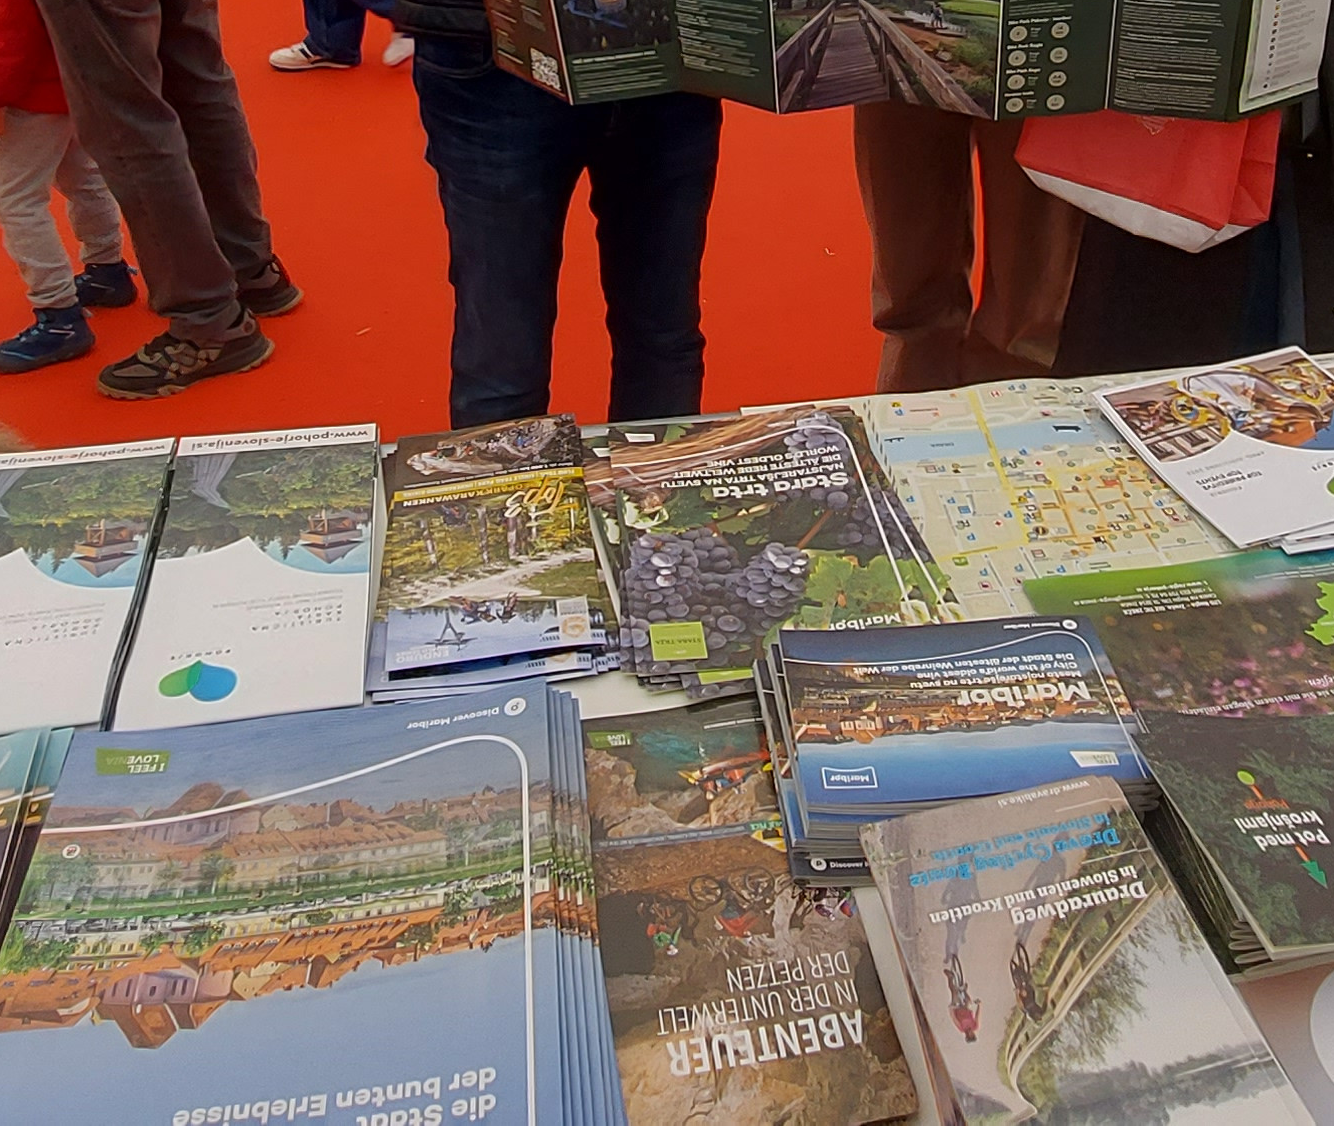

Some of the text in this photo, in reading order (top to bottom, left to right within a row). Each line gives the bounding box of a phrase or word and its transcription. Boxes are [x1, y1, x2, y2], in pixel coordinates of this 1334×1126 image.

[191, 430, 369, 451] www.pohorje-slovenija.si
[673, 453, 841, 479] DIE ÄLTESTE REBE WELTWEIT
[737, 453, 783, 466] OLDEST
[661, 462, 845, 489] NAJSTAREJŠA TRTA NA SVETU
[713, 472, 849, 499] Stara trta
[853, 653, 1075, 675] Die Stadt der ältesten Weinrebe der Welt
[916, 661, 1078, 679] City of the world's oldest vine
[1055, 670, 1082, 679] Mesto
[909, 680, 942, 689] svetu
[944, 678, 958, 686] na
[959, 675, 980, 685] trte
[957, 682, 1093, 708] Maribor
[1254, 696, 1283, 707] einem
[1284, 693, 1300, 704] mit
[407, 706, 500, 729] Discover Maribor
[128, 763, 157, 773] FEEL
[830, 774, 870, 784] Maribor
[997, 778, 1090, 809] www.dravabike.si
[1233, 809, 1325, 835] krošnjami
[1054, 827, 1121, 855] Drava
[1253, 828, 1331, 853] Pot med
[829, 860, 864, 870] Discover
[929, 864, 1138, 925] in Slowenien und Kroatien
[1010, 879, 1149, 925] Drauradweg
[726, 950, 851, 993] DER PETZEN
[656, 978, 859, 1036] IN DER UNTERWELT
[666, 1008, 865, 1077] ABENTEUER
[172, 1067, 497, 1126] der bunten Erlebnisse
[451, 1093, 497, 1121] die
